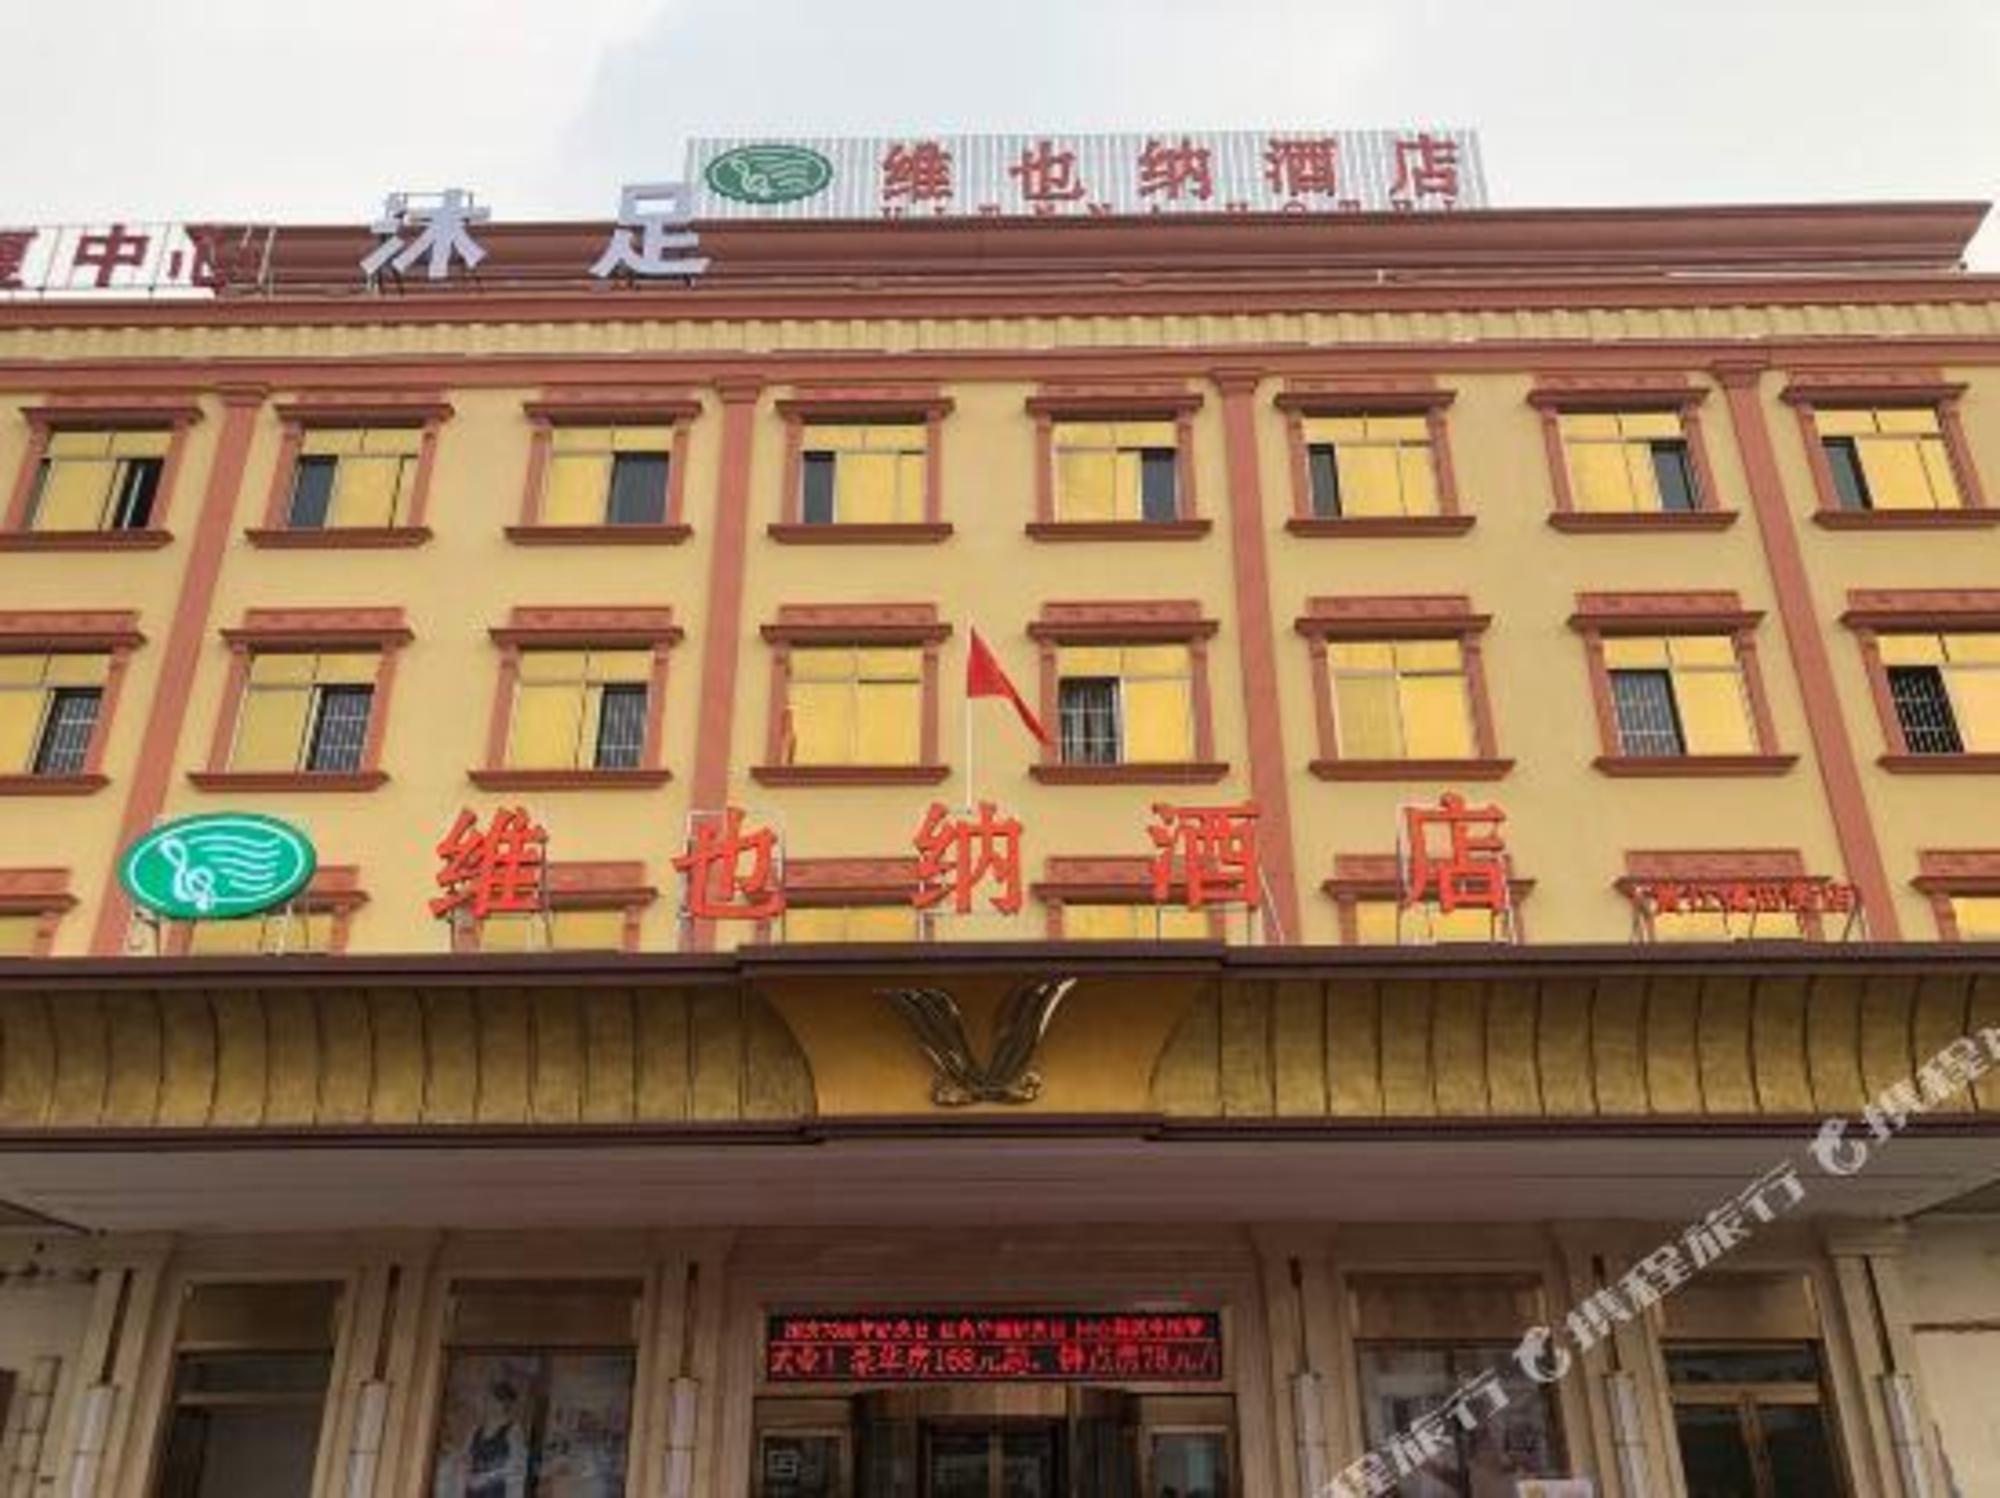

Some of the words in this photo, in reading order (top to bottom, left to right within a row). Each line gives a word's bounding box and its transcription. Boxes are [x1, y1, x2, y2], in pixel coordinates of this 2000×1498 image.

[882, 133, 1459, 200] 维也纳酒店
[361, 182, 710, 283] 沐足
[428, 792, 1506, 920] 维也纳酒店
